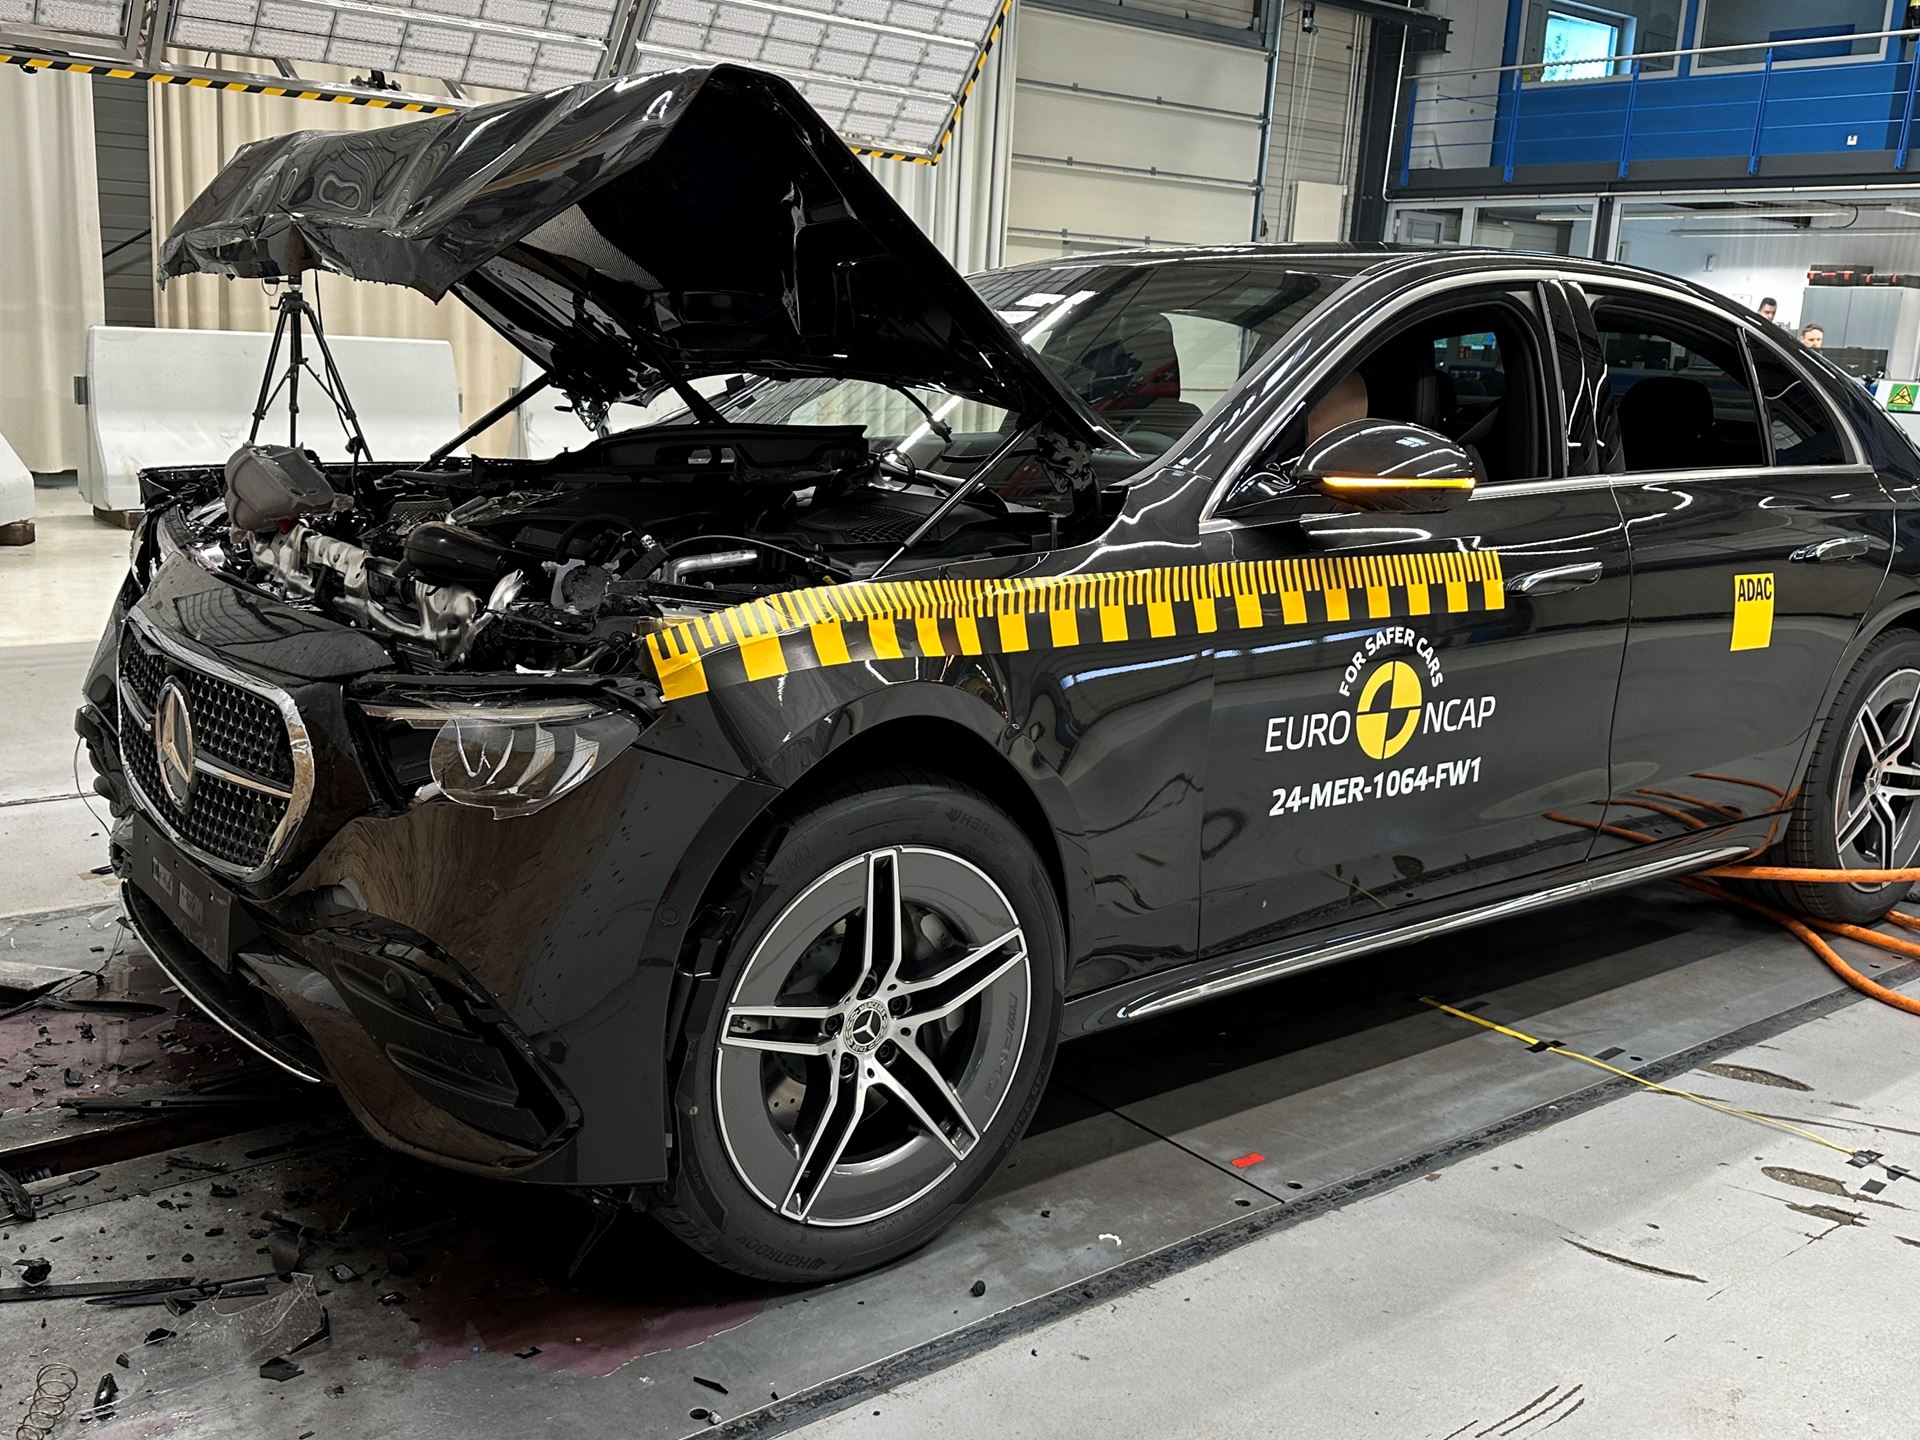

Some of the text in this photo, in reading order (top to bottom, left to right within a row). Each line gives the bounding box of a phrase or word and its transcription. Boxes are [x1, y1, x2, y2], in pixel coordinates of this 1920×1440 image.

[1737, 576, 1772, 603] ADAC
[1338, 626, 1444, 698] FOR SAFER CARS
[1264, 695, 1497, 753] EURO NCAP
[1268, 756, 1482, 817] 24-MER-1064-FW1
